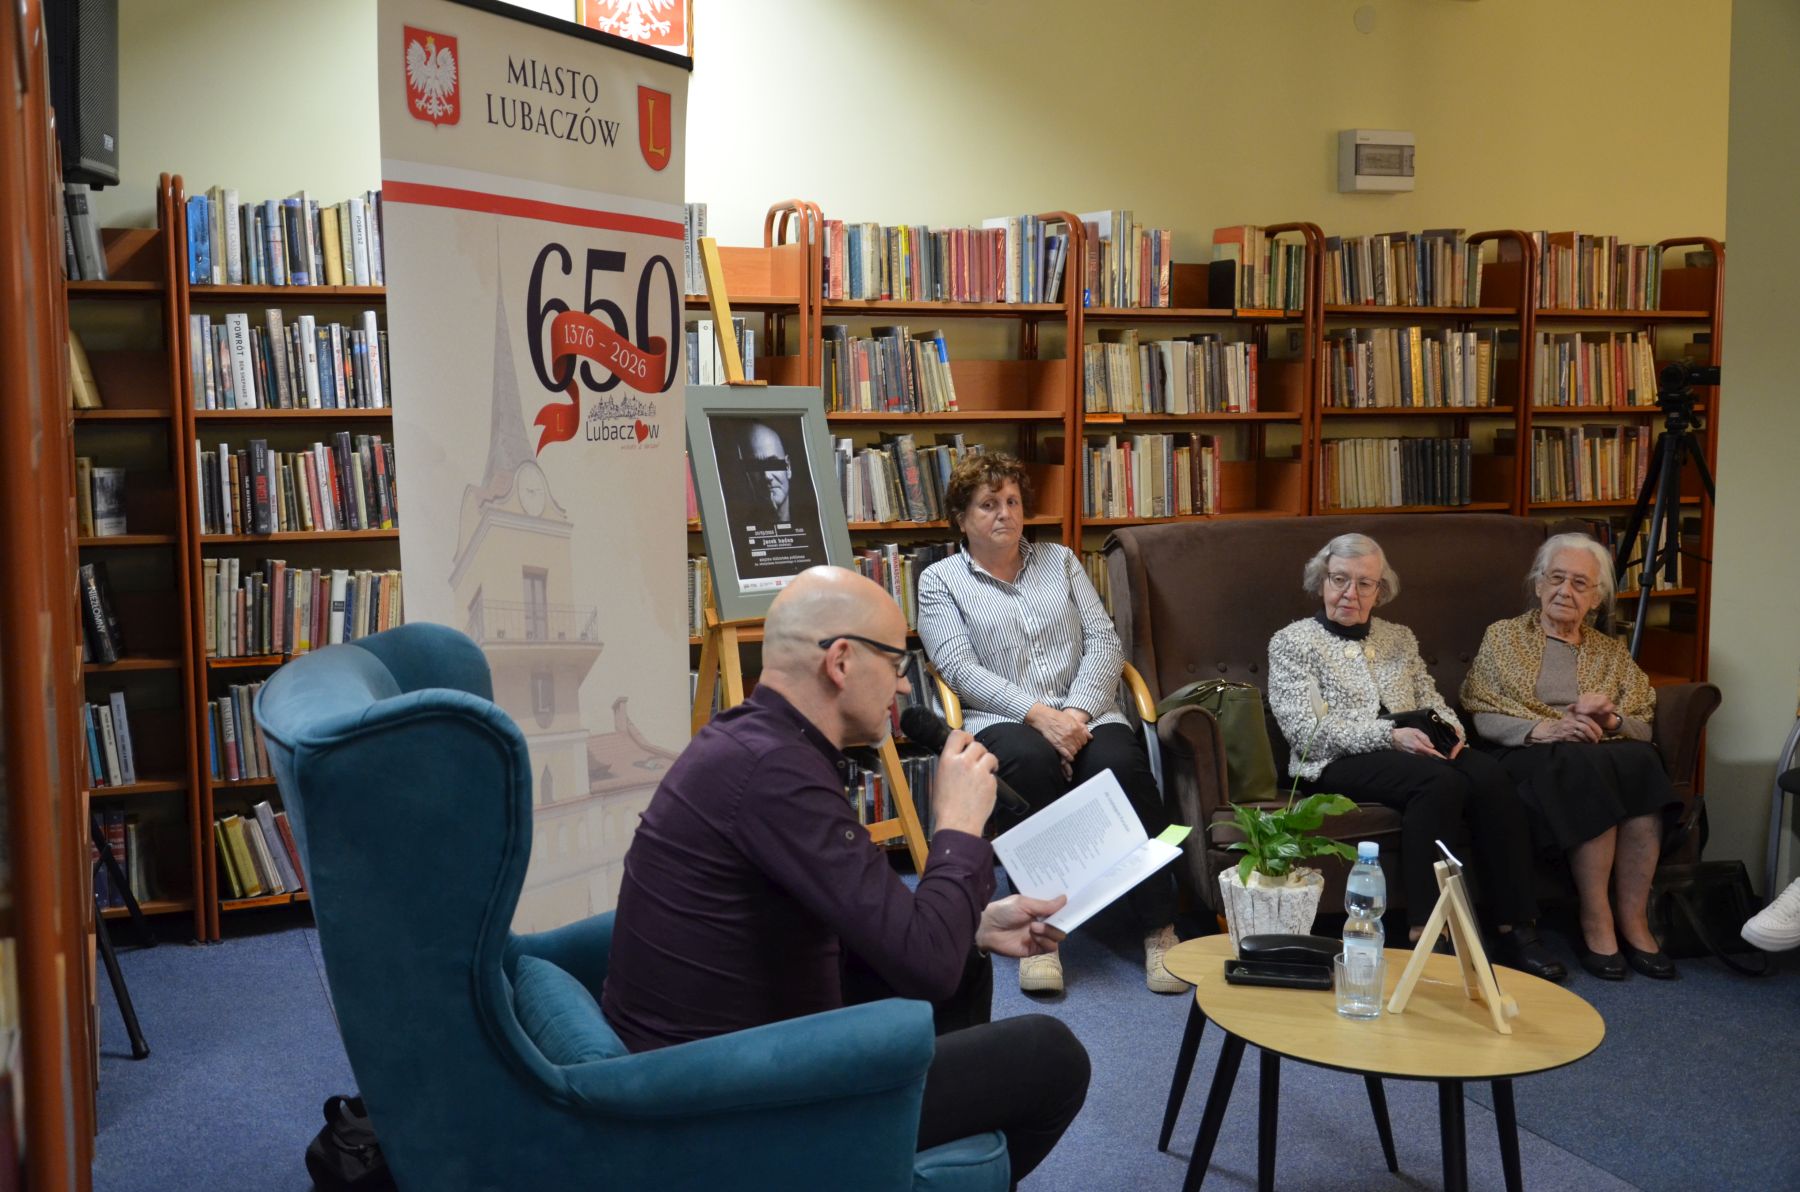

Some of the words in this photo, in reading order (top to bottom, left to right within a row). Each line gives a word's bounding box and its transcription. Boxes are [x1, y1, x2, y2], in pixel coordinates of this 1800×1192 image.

[507, 54, 599, 104] MIASTO
[486, 93, 620, 149] LUBACZÓW
[233, 320, 245, 356] POWRÓT
[527, 242, 681, 394] 650
[564, 324, 594, 348] 1376
[609, 341, 647, 378] 2026
[86, 585, 106, 634] NIEZŁOMNY
[223, 703, 235, 738] KUBIAK
